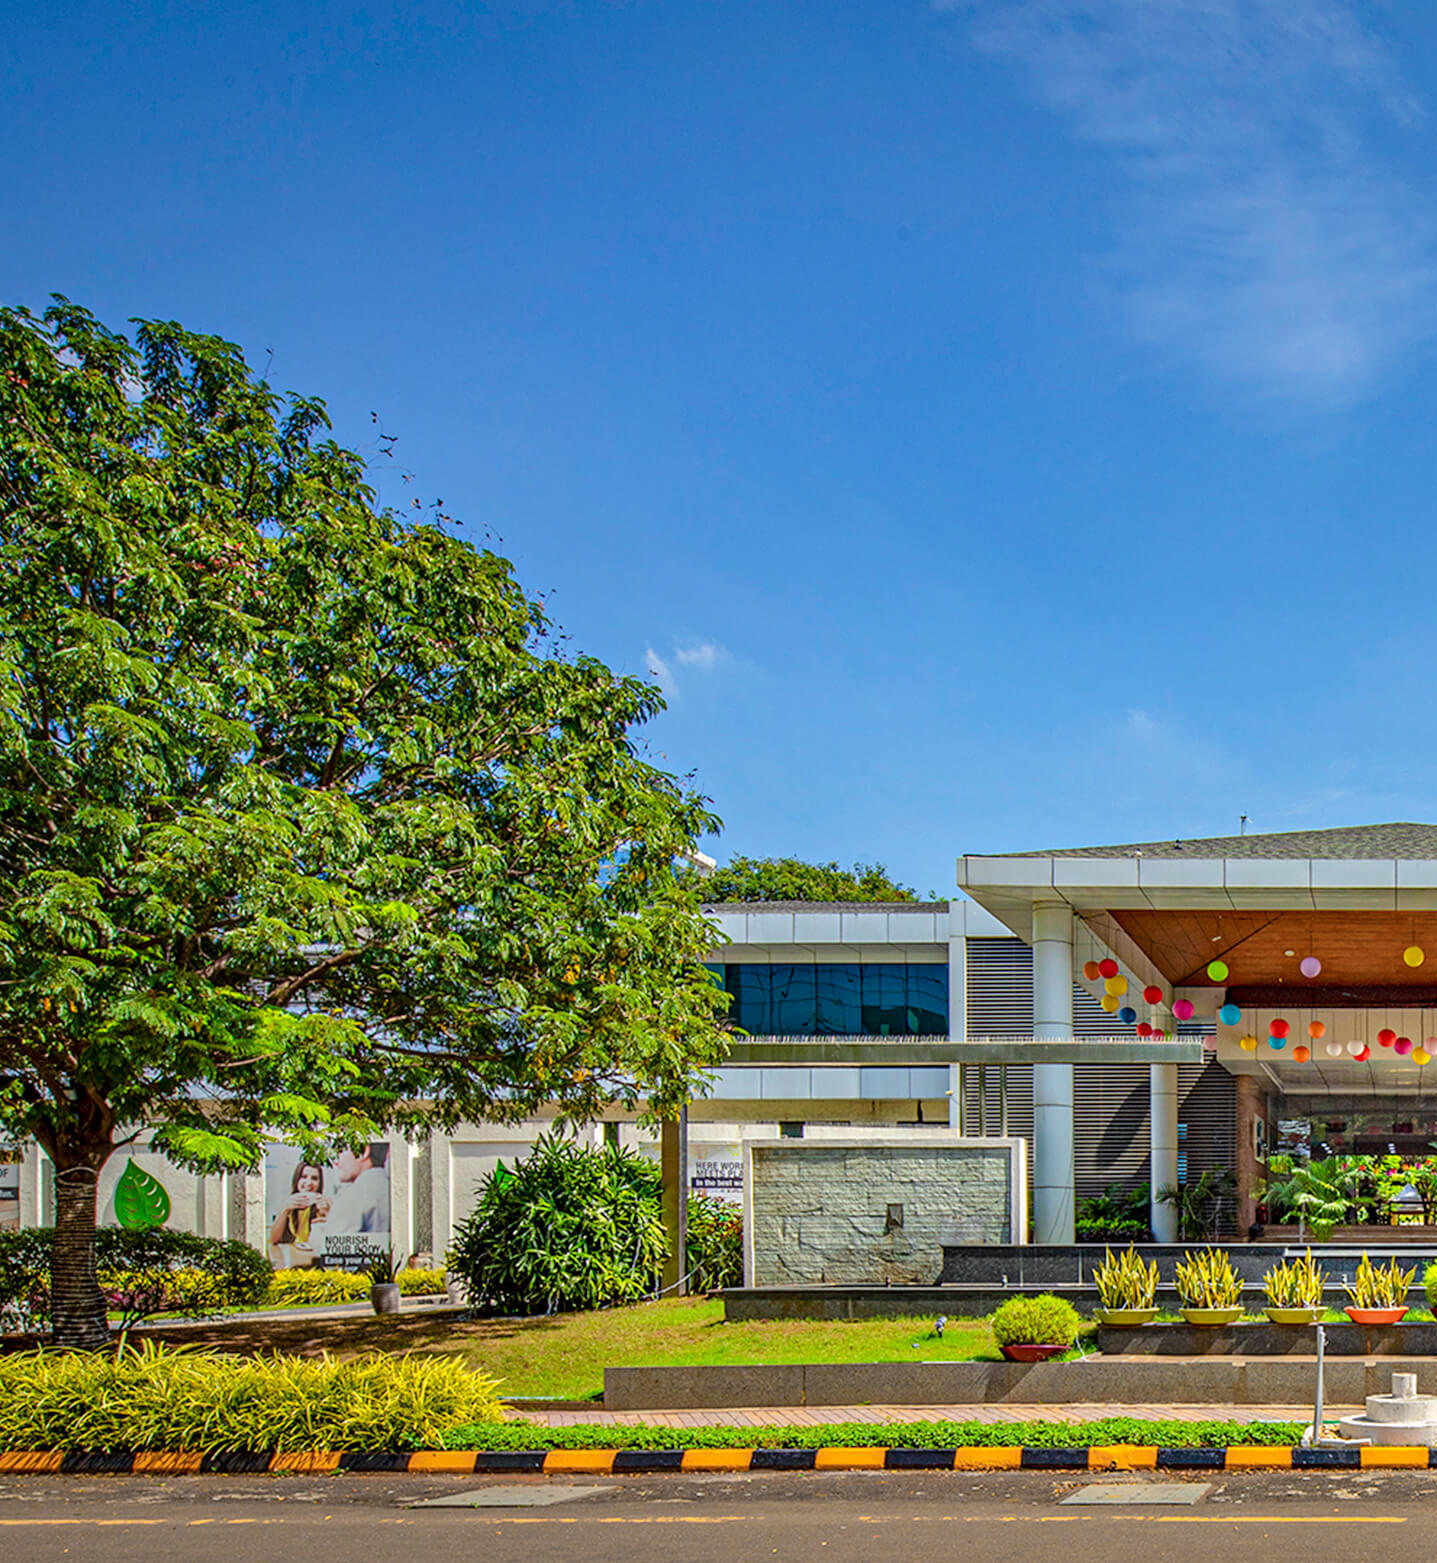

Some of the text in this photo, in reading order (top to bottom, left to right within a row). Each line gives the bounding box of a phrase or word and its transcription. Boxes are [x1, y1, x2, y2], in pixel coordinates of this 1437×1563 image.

[696, 1161, 718, 1169] HERE
[697, 1169, 725, 1178] MEETS
[325, 1236, 368, 1244] NOURISH
[325, 1245, 381, 1254] YOUR BODY
